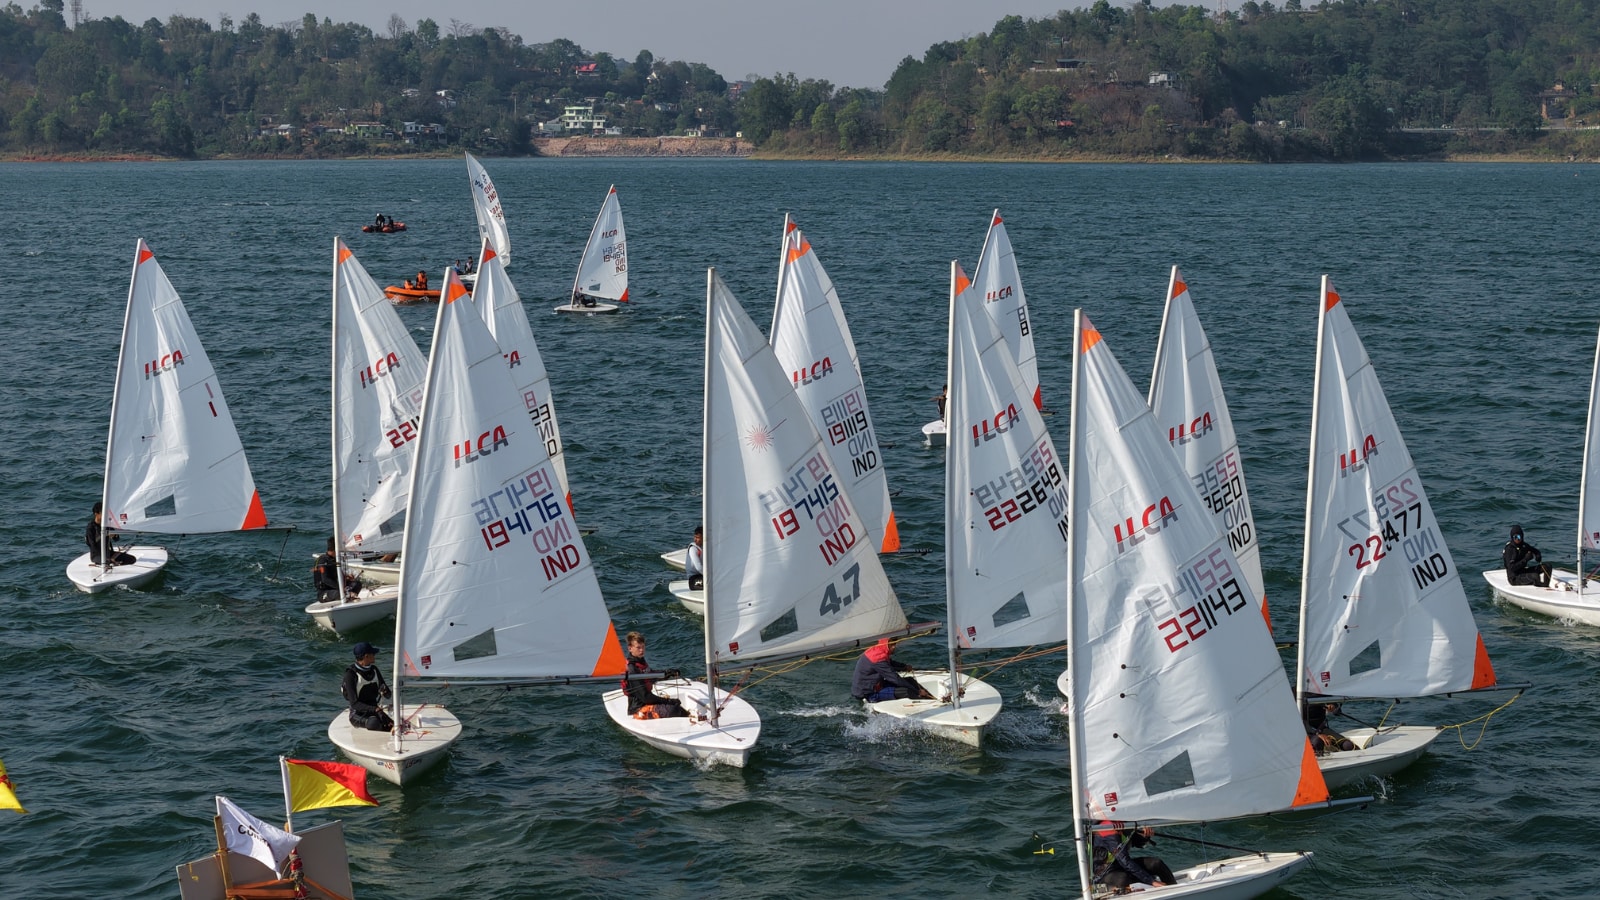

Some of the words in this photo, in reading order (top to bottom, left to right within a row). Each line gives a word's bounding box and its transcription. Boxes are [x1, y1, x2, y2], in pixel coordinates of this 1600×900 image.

[602, 229, 618, 240] ILCA
[616, 264, 626, 273] IND
[986, 285, 1012, 304] ILCA
[1020, 321, 1029, 336] 8
[144, 350, 184, 380] ILCA
[360, 352, 400, 389] ILCA
[793, 356, 834, 390] ILCA
[828, 410, 868, 447] 191119
[972, 403, 1020, 448] ILCA
[1168, 411, 1214, 448] ILCA
[454, 425, 508, 469] ILCA
[852, 450, 876, 478] IND
[772, 474, 839, 540] 197415
[984, 462, 1061, 532] 222649
[481, 492, 562, 552] 194176
[1113, 496, 1179, 554] ILCA
[1228, 522, 1252, 552] IND
[540, 544, 580, 581] IND
[820, 522, 856, 566] IND
[820, 562, 860, 617] 4.7
[1412, 552, 1448, 590] IND
[1158, 578, 1247, 653] 221143
